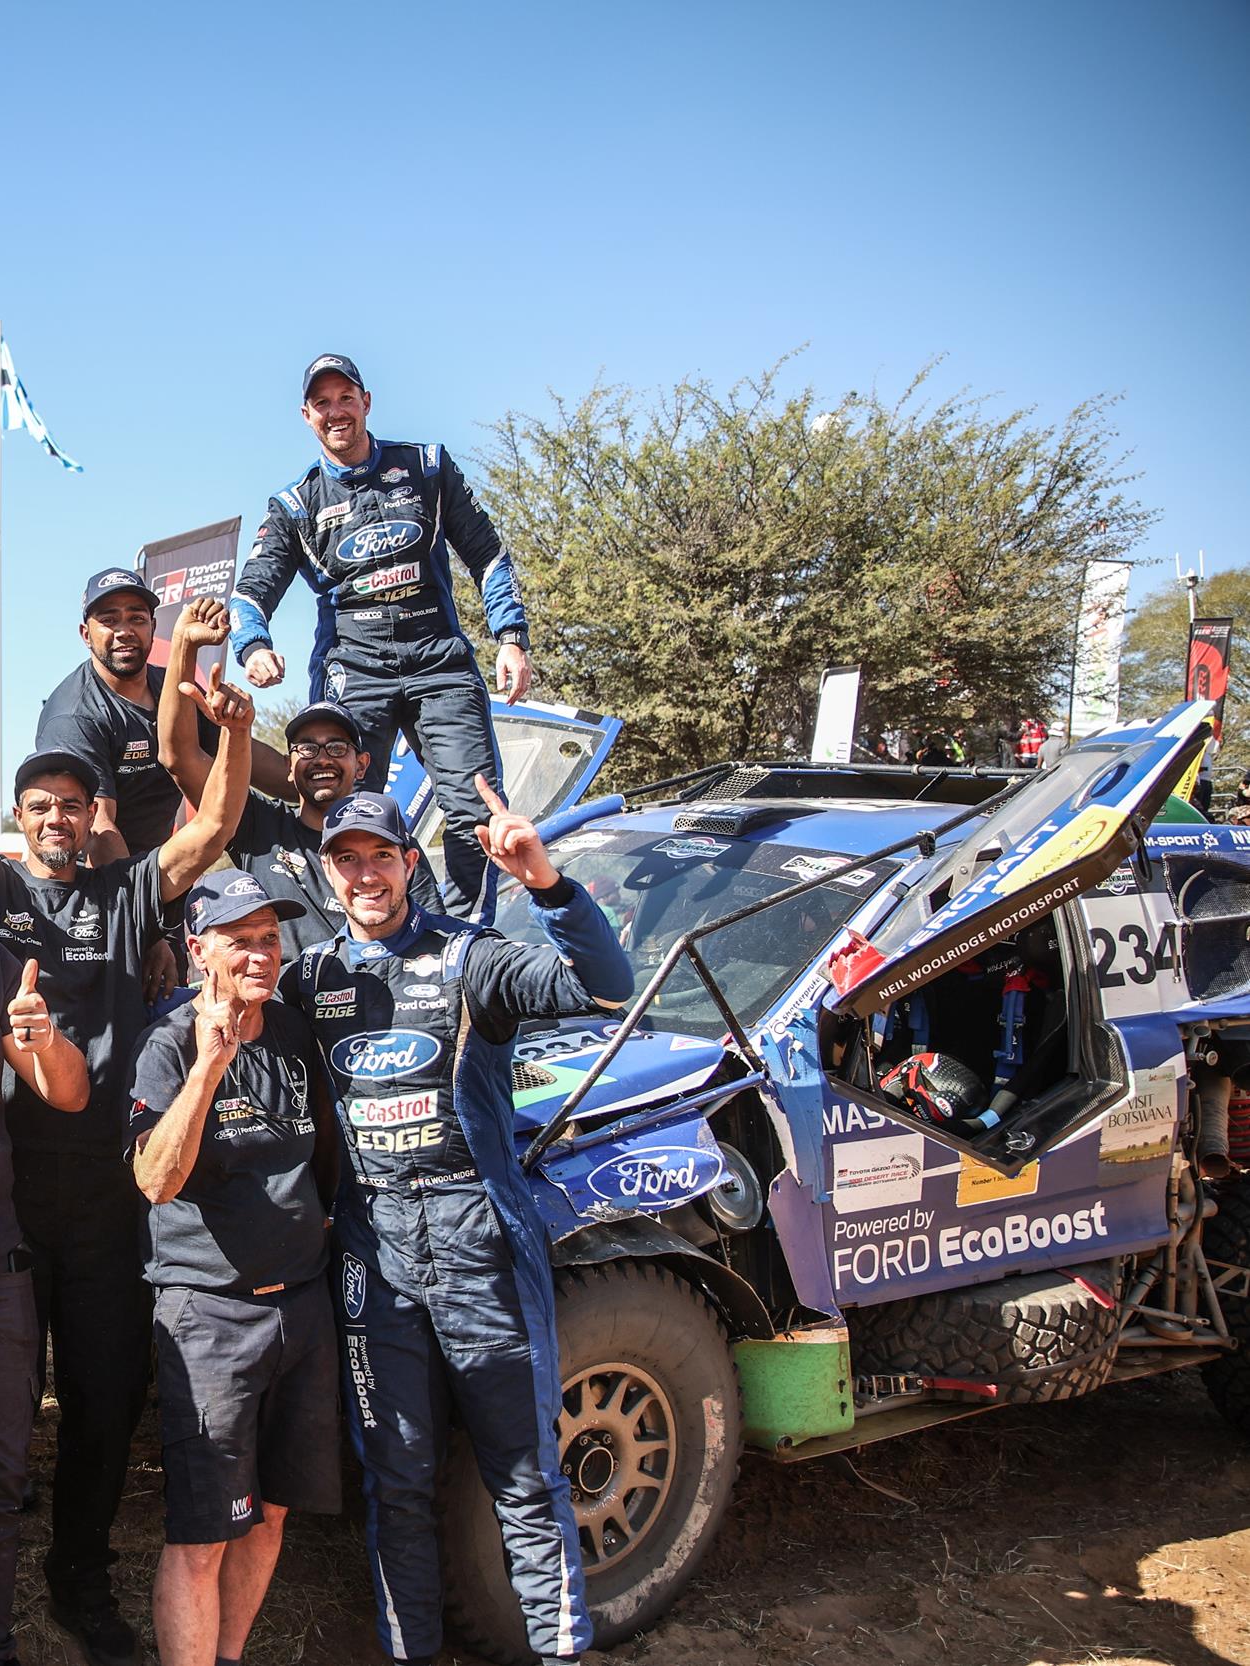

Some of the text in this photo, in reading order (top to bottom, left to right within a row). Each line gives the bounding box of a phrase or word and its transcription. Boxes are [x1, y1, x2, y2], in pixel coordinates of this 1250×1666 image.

[383, 500, 401, 510] Ford
[352, 526, 408, 557] Ford
[188, 559, 235, 578] TOYOTA
[371, 564, 417, 589] Castrol
[185, 571, 230, 588] GAZOO
[183, 582, 227, 599] Racing
[123, 750, 151, 760] EDGE
[342, 802, 380, 816] Ford
[1143, 836, 1200, 847] M-SPORT
[74, 925, 99, 938] Ford
[878, 876, 1081, 1000] NEIL WOOLRIDGE MOTORSPORT
[88, 946, 95, 954] by
[1091, 922, 1181, 988] 234
[324, 988, 354, 1004] Castrol
[394, 998, 450, 1011] Ford Credit
[315, 1004, 357, 1019] EDGE
[345, 1036, 418, 1072] Ford
[519, 1032, 602, 1061] 234
[366, 1095, 431, 1123] Castrol
[1127, 1093, 1154, 1109] VISIT
[1108, 1106, 1173, 1128] BOTSWANA
[356, 1122, 445, 1153] EDGE
[617, 1154, 700, 1196] Ford
[891, 1170, 909, 1178] RACE
[970, 1176, 993, 1187] Number
[833, 1207, 935, 1241] Powered by
[833, 1201, 1109, 1291] FORD EcoBoost
[346, 1260, 364, 1306] Ford
[358, 1335, 376, 1390] Powered by
[347, 1334, 378, 1429] EcoBoost
